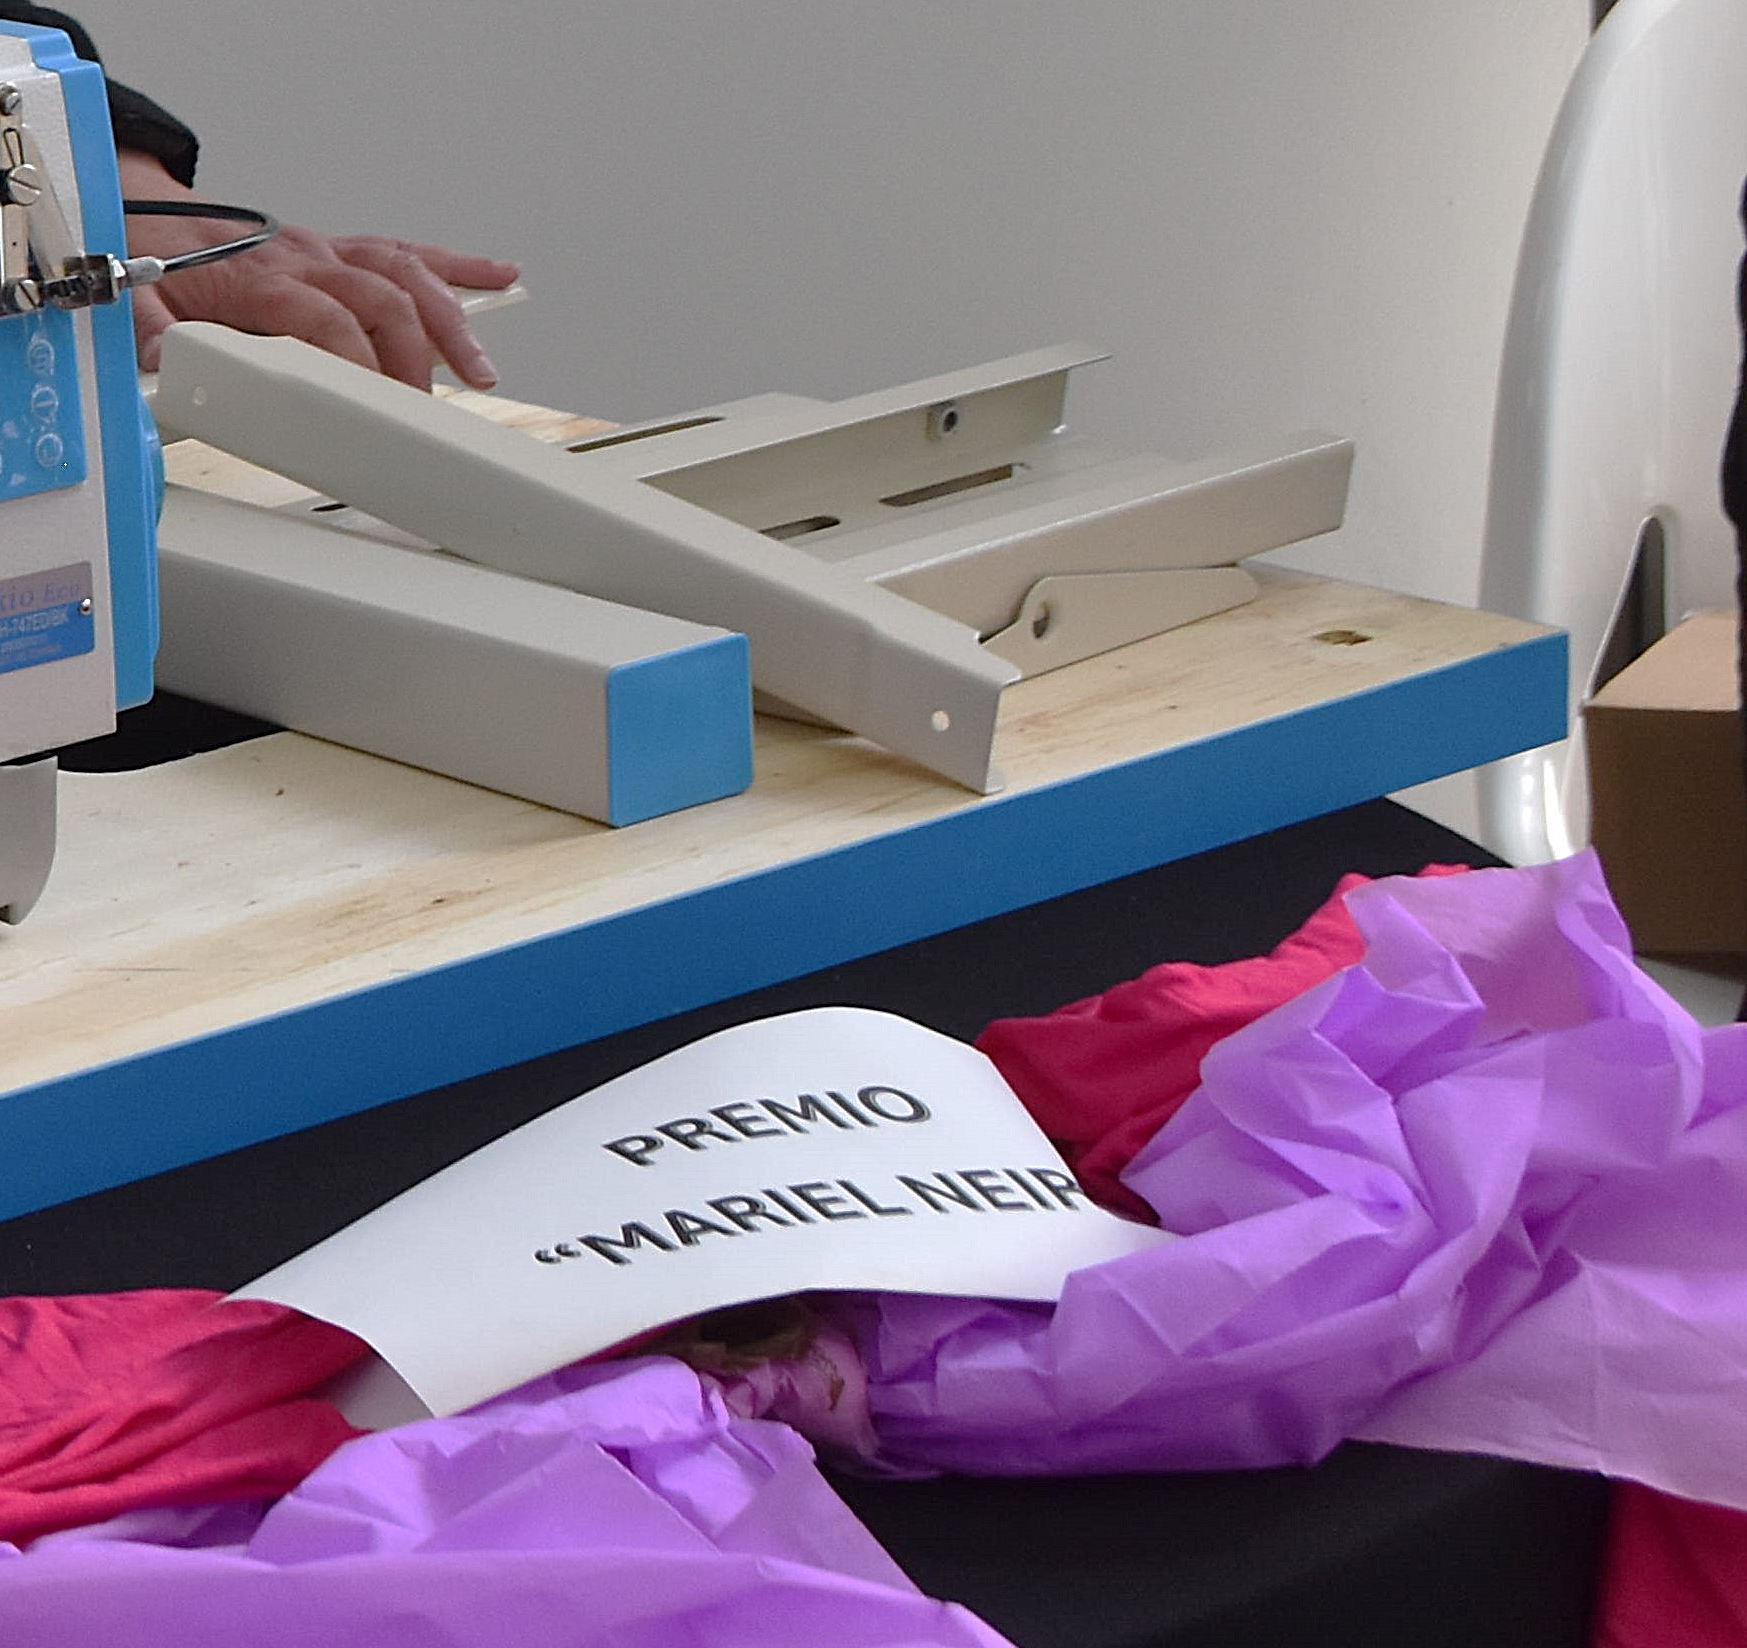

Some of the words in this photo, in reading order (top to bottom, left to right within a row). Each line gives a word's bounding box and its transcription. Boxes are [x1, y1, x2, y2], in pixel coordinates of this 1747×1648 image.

[43, 580, 82, 602] Eco
[602, 1084, 932, 1168] PREMIO
[533, 1177, 915, 1268] “MARIEL
